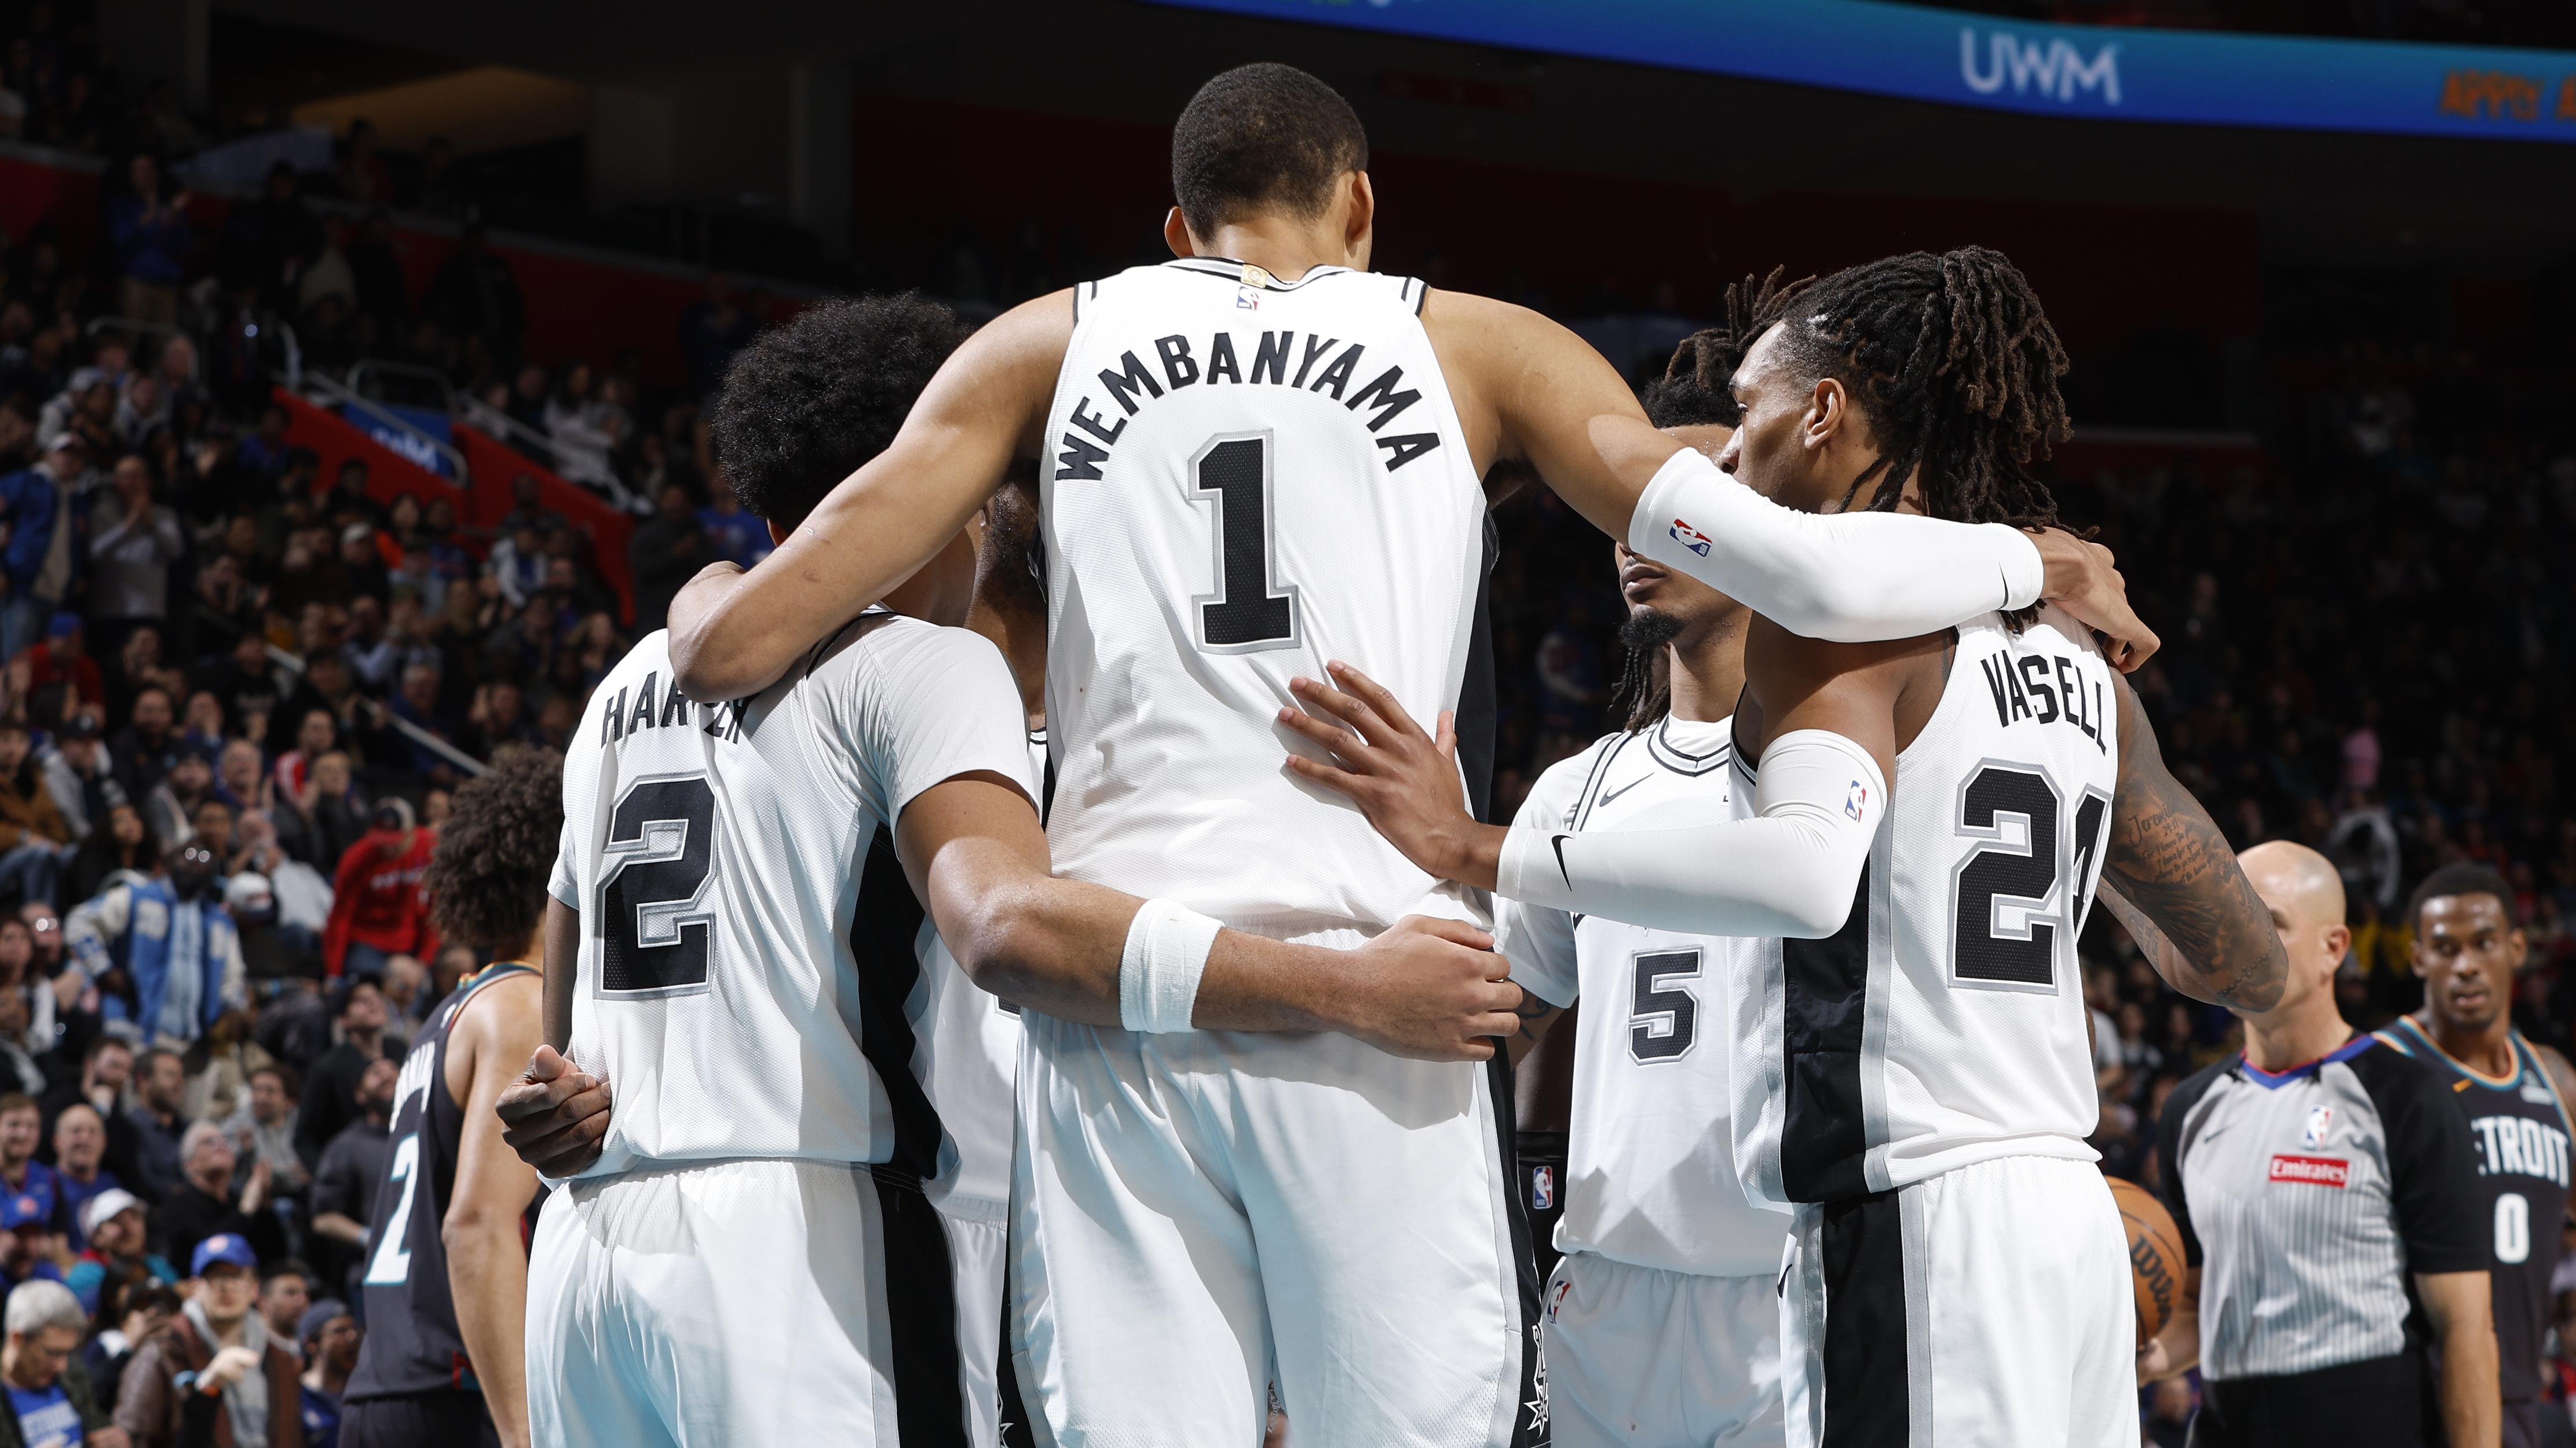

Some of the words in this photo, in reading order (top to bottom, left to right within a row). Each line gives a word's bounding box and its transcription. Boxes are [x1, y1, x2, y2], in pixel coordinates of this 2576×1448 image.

[1960, 27, 2121, 106] UWM
[1055, 331, 1441, 481] WEMBANYAMA
[1188, 427, 1302, 654] 1
[1698, 544, 1708, 556] NBA
[593, 769, 721, 1000] 2
[1628, 945, 1704, 1066] 5
[363, 1132, 419, 1286] 2
[2271, 1158, 2346, 1181] Emirates
[2494, 1193, 2530, 1264] 0
